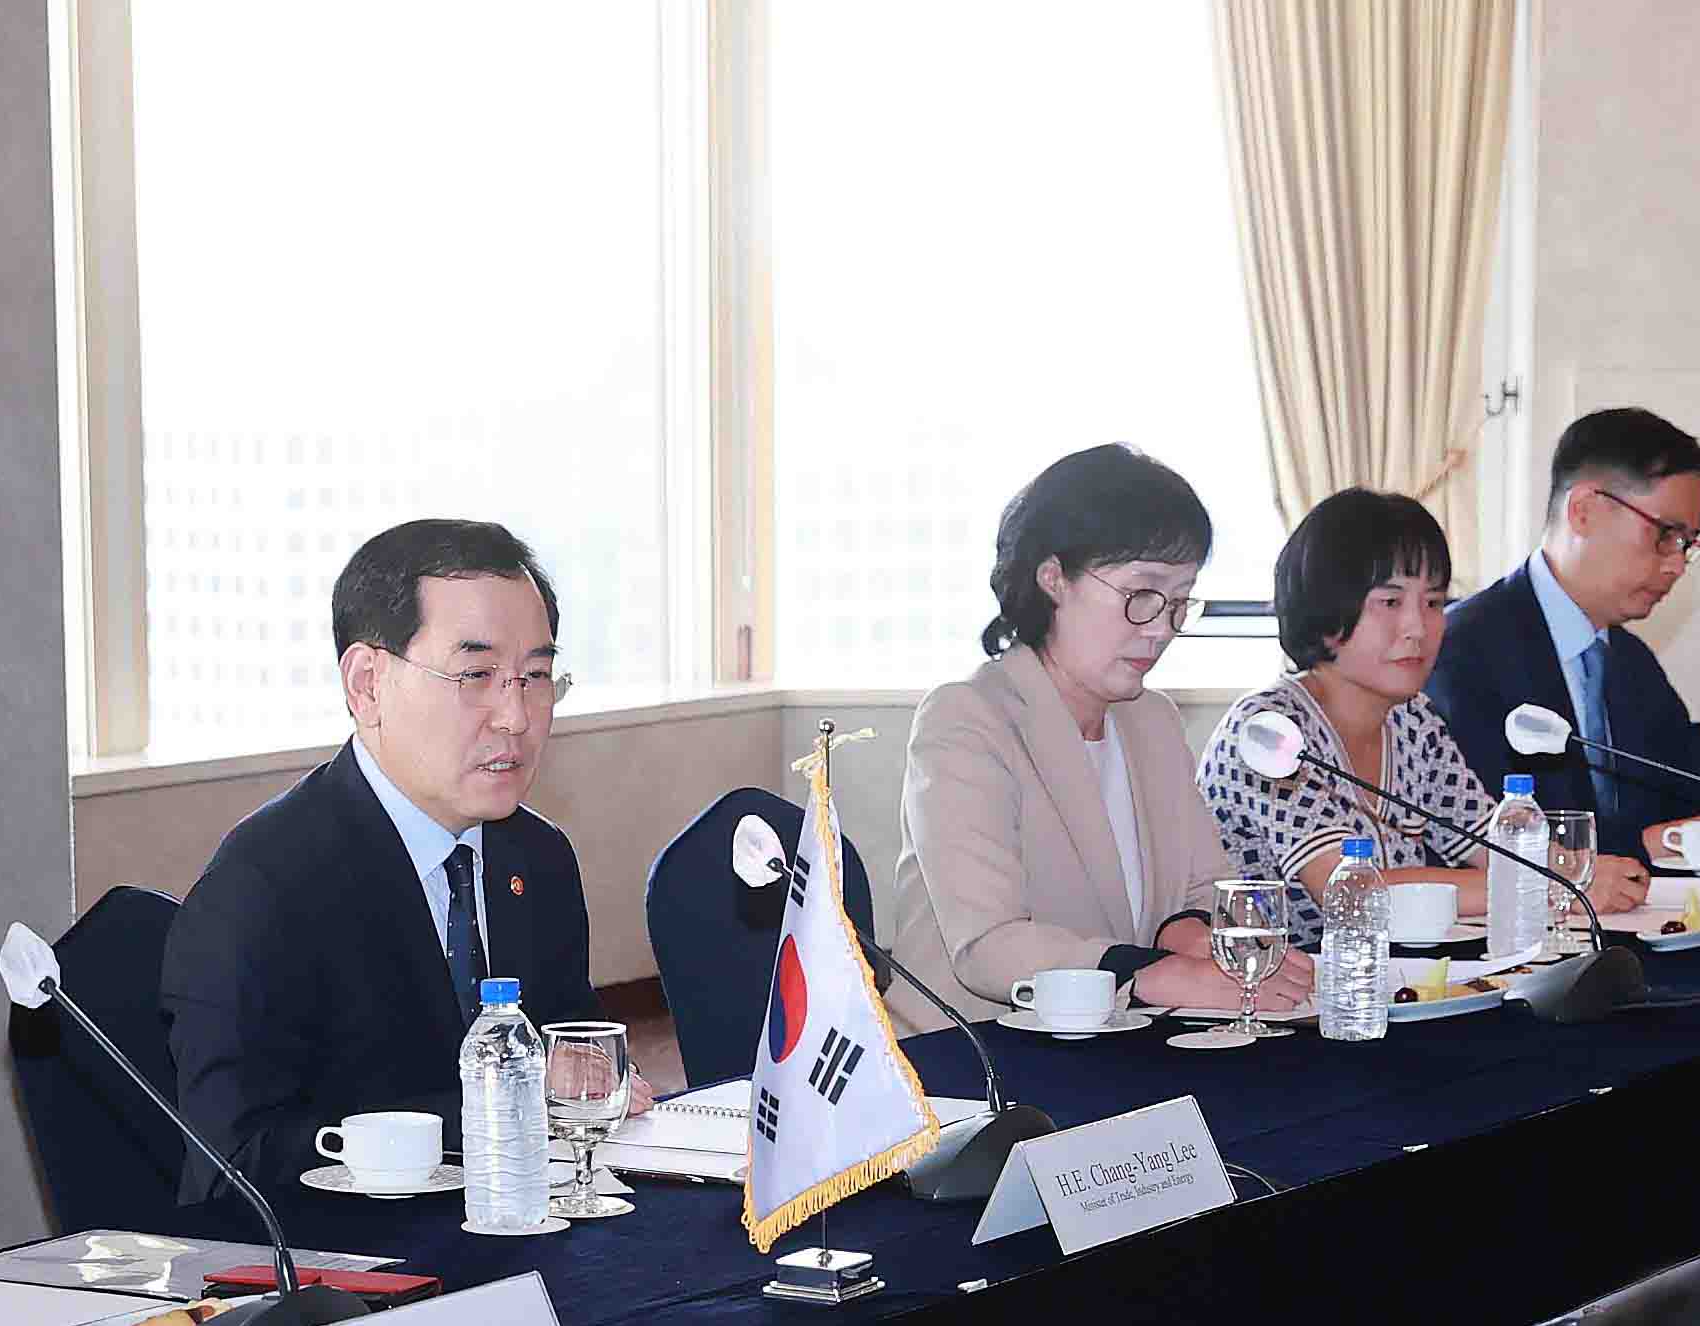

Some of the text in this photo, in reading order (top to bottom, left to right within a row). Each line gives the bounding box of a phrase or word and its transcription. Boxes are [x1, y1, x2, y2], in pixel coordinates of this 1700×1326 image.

[1055, 1142, 1197, 1197] H.E. Chang-Yang Lee
